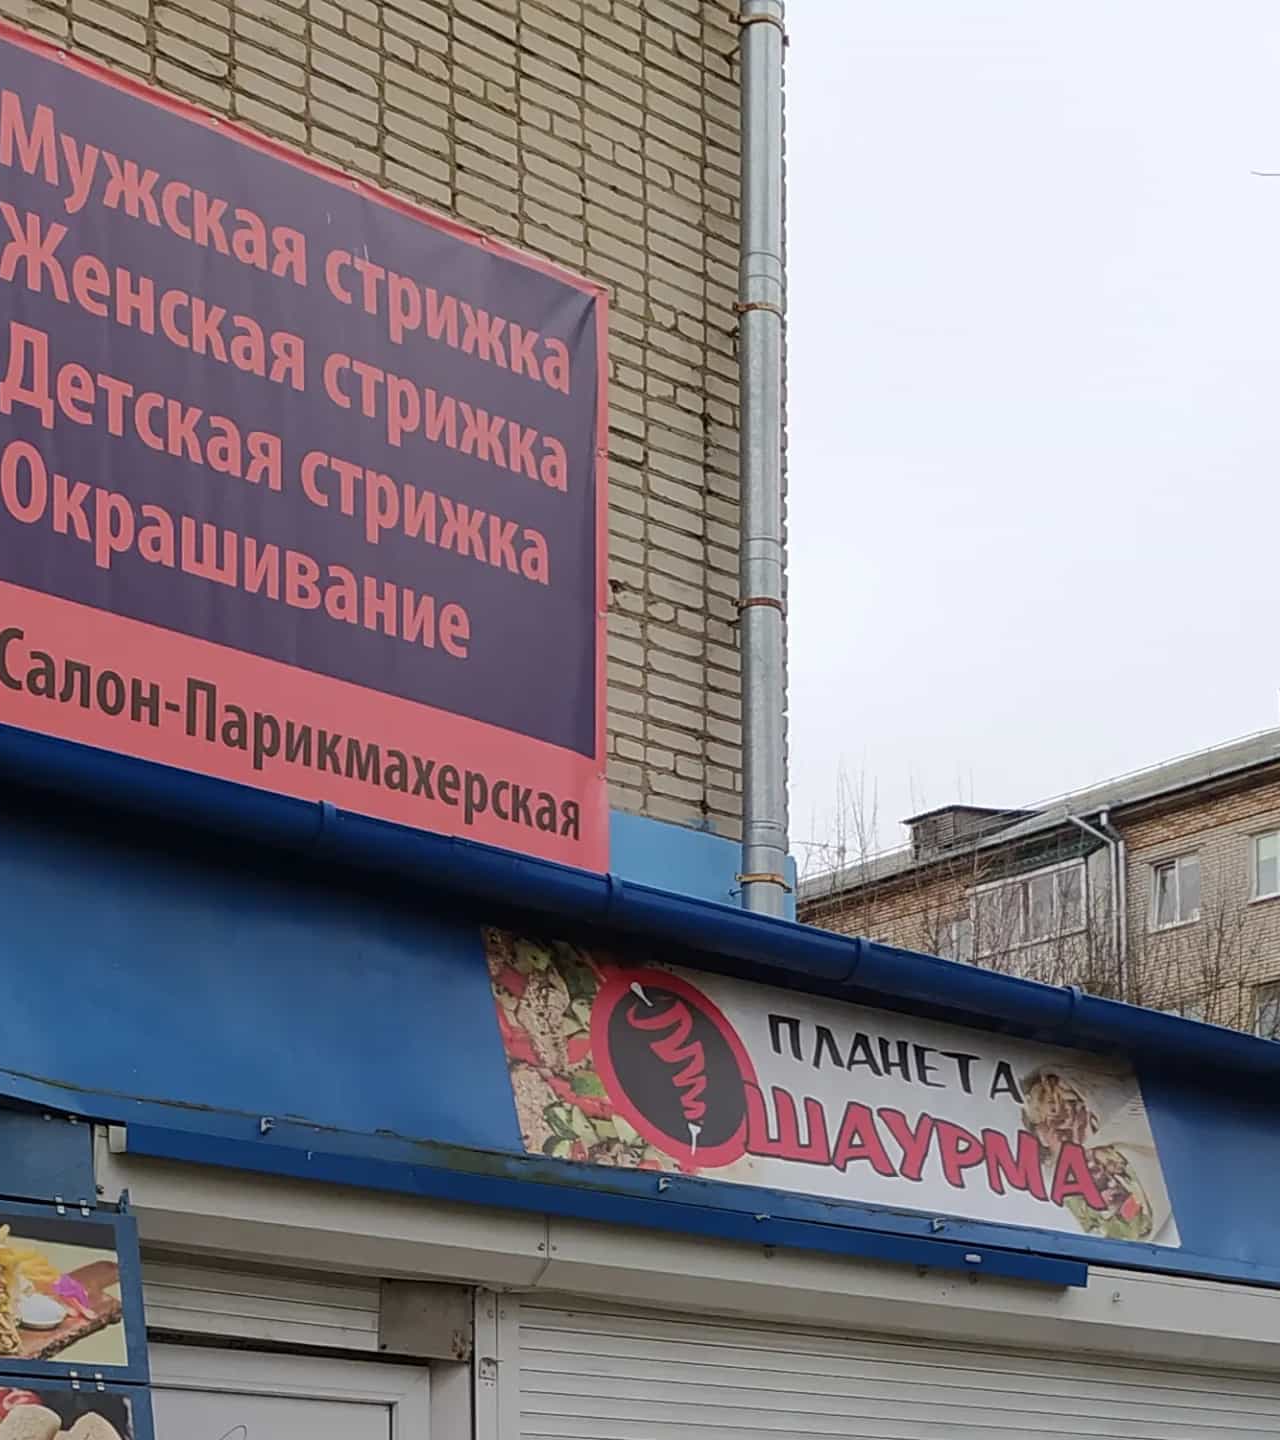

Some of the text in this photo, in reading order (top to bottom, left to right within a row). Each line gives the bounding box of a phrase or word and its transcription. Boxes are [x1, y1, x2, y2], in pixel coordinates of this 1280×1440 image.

[324, 246, 573, 395] стрижка
[323, 353, 569, 493] стрижка
[0, 440, 472, 659] Окрашивание
[300, 451, 551, 585] стрижка
[767, 1013, 1024, 1104] ПЛАНЕТА
[744, 1084, 1108, 1212] ШАУРМА
